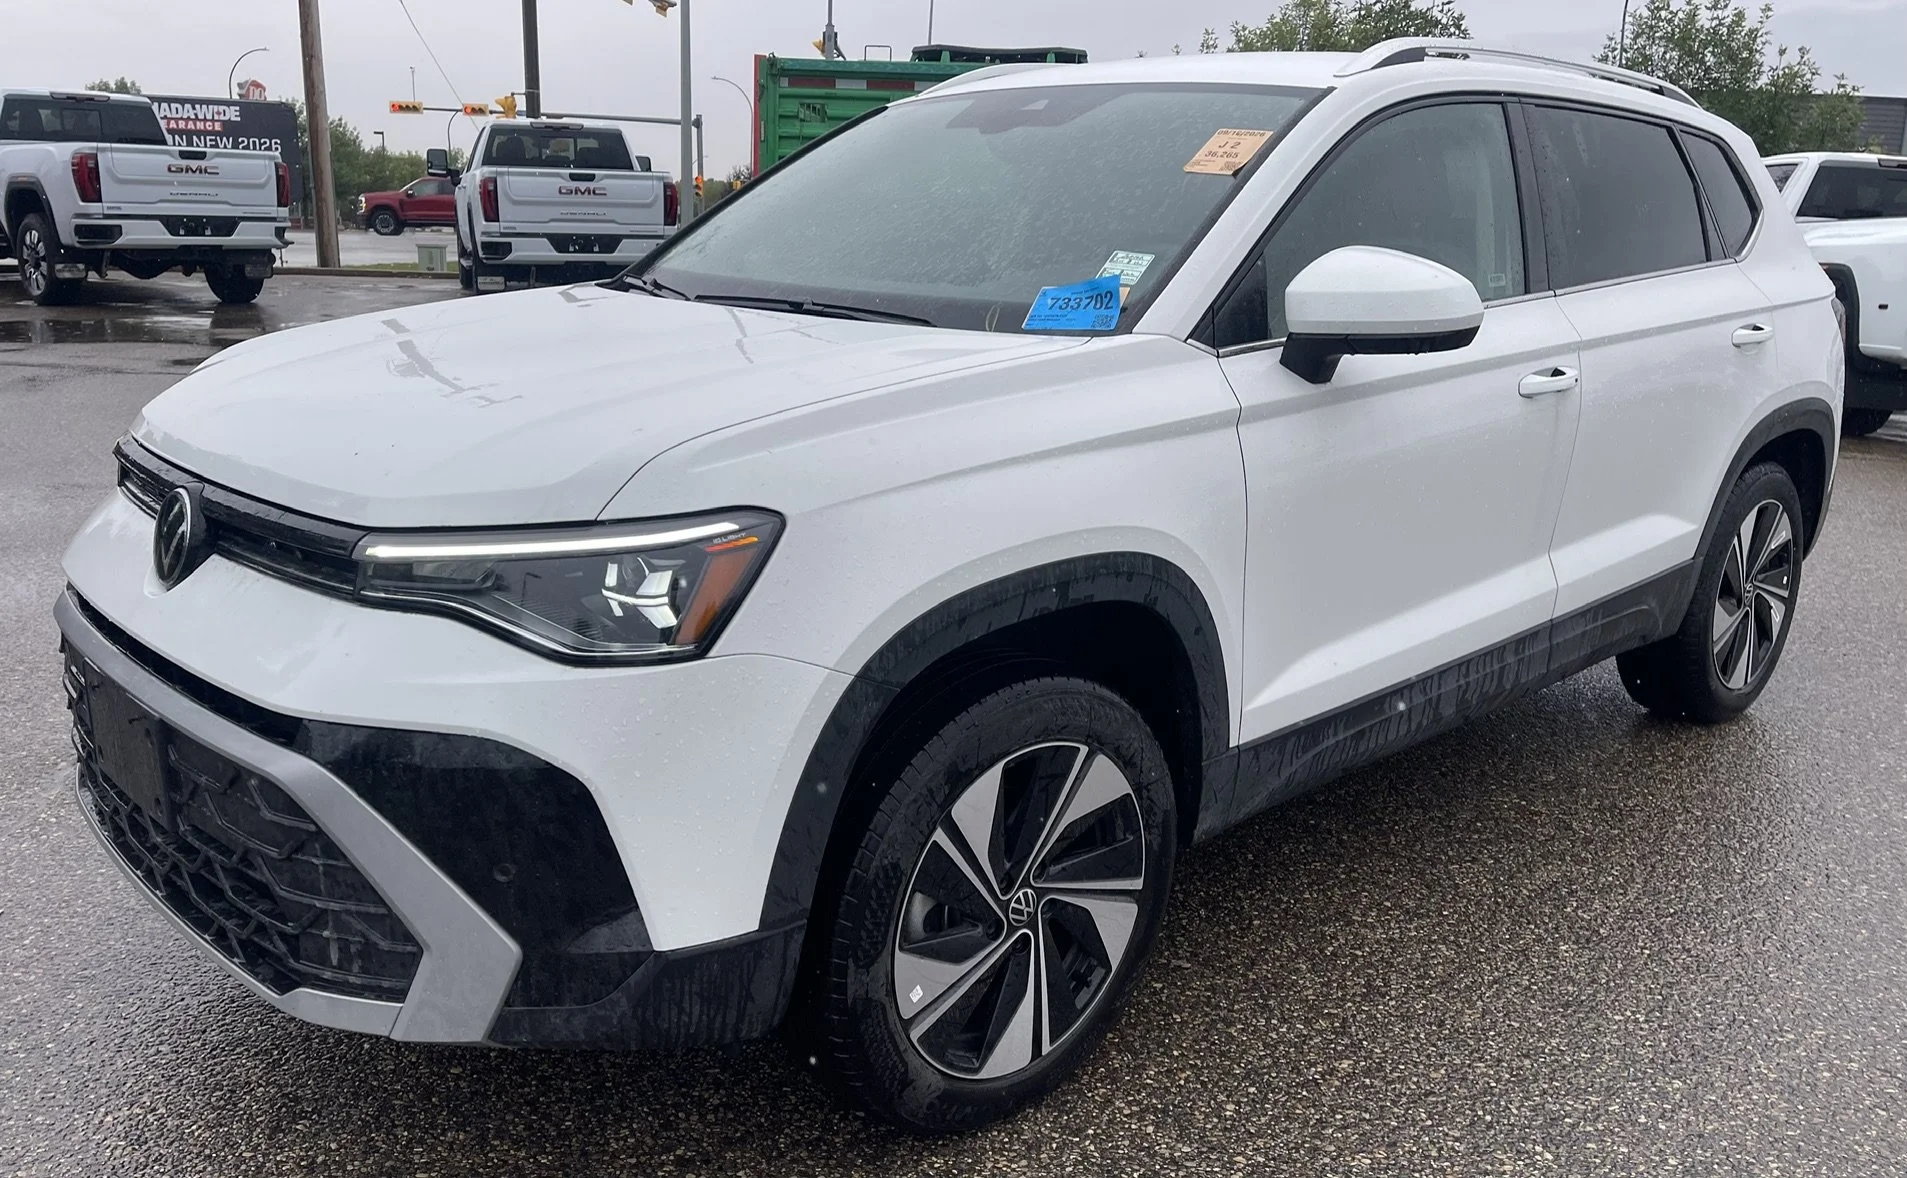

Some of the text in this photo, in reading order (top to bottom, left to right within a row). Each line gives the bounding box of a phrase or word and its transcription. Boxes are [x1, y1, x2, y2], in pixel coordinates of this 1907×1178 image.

[193, 135, 232, 149] NEW
[238, 137, 281, 153] 2026
[1230, 141, 1241, 149] 2
[167, 164, 220, 176] GMC
[559, 185, 607, 196] GMC
[1048, 290, 1114, 311] 733702
